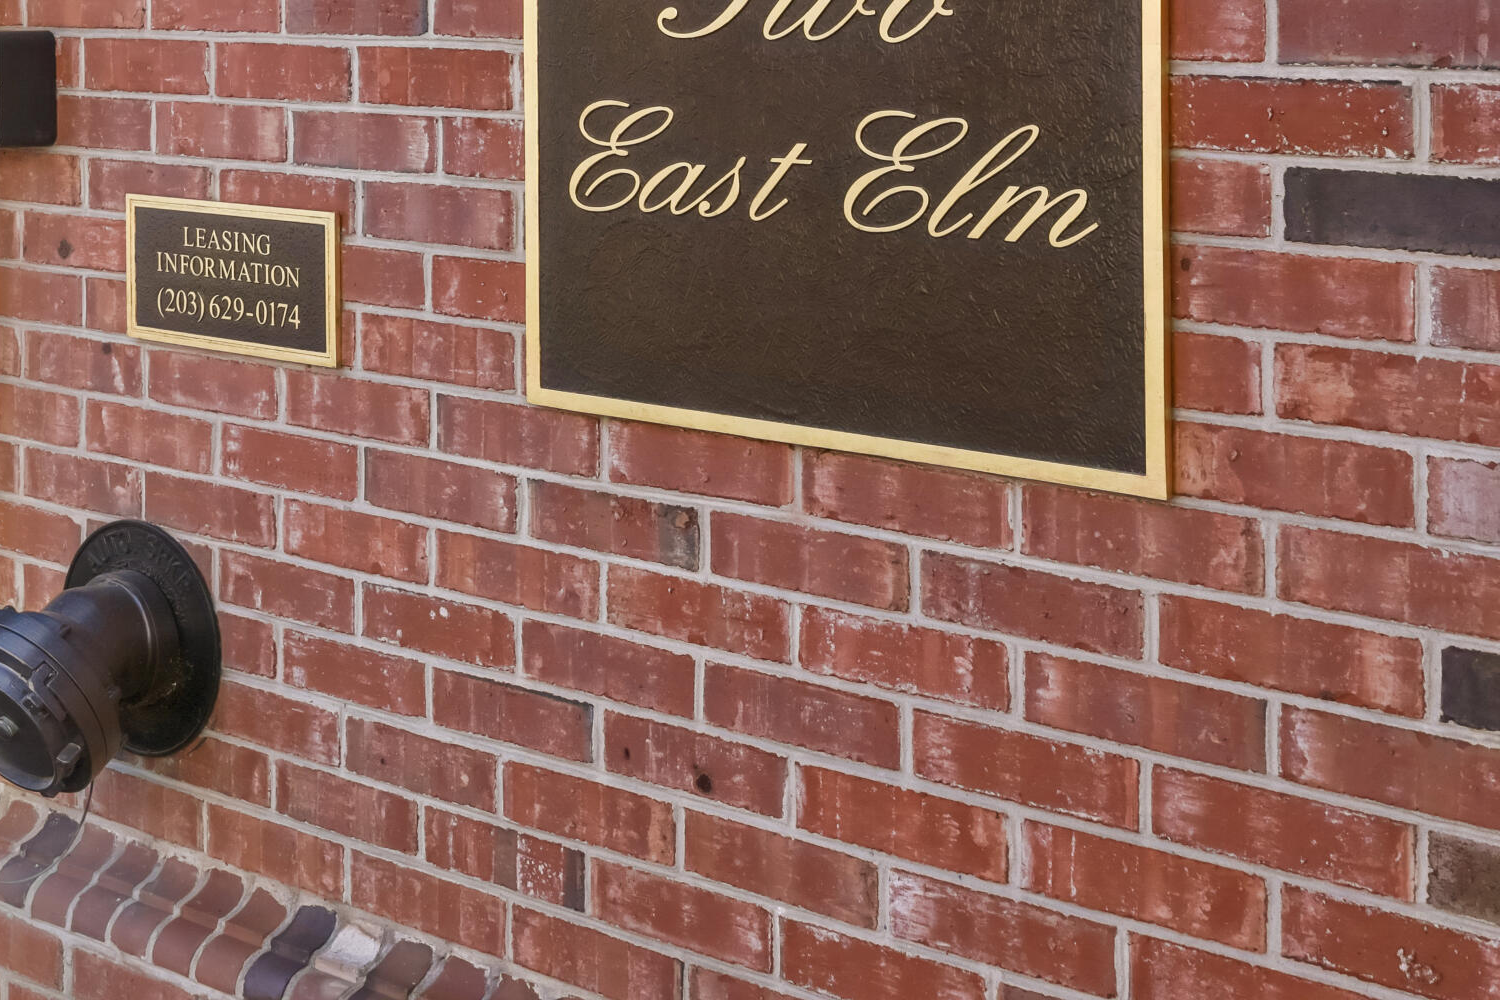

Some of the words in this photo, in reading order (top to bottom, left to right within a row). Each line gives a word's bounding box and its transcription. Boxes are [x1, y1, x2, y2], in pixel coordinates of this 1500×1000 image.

[568, 99, 813, 222] East
[843, 110, 1099, 249] Elm
[182, 226, 271, 256] LEASING
[156, 251, 301, 288] INFORMATION
[157, 287, 205, 323] (203)
[209, 294, 301, 330] 629-0174
